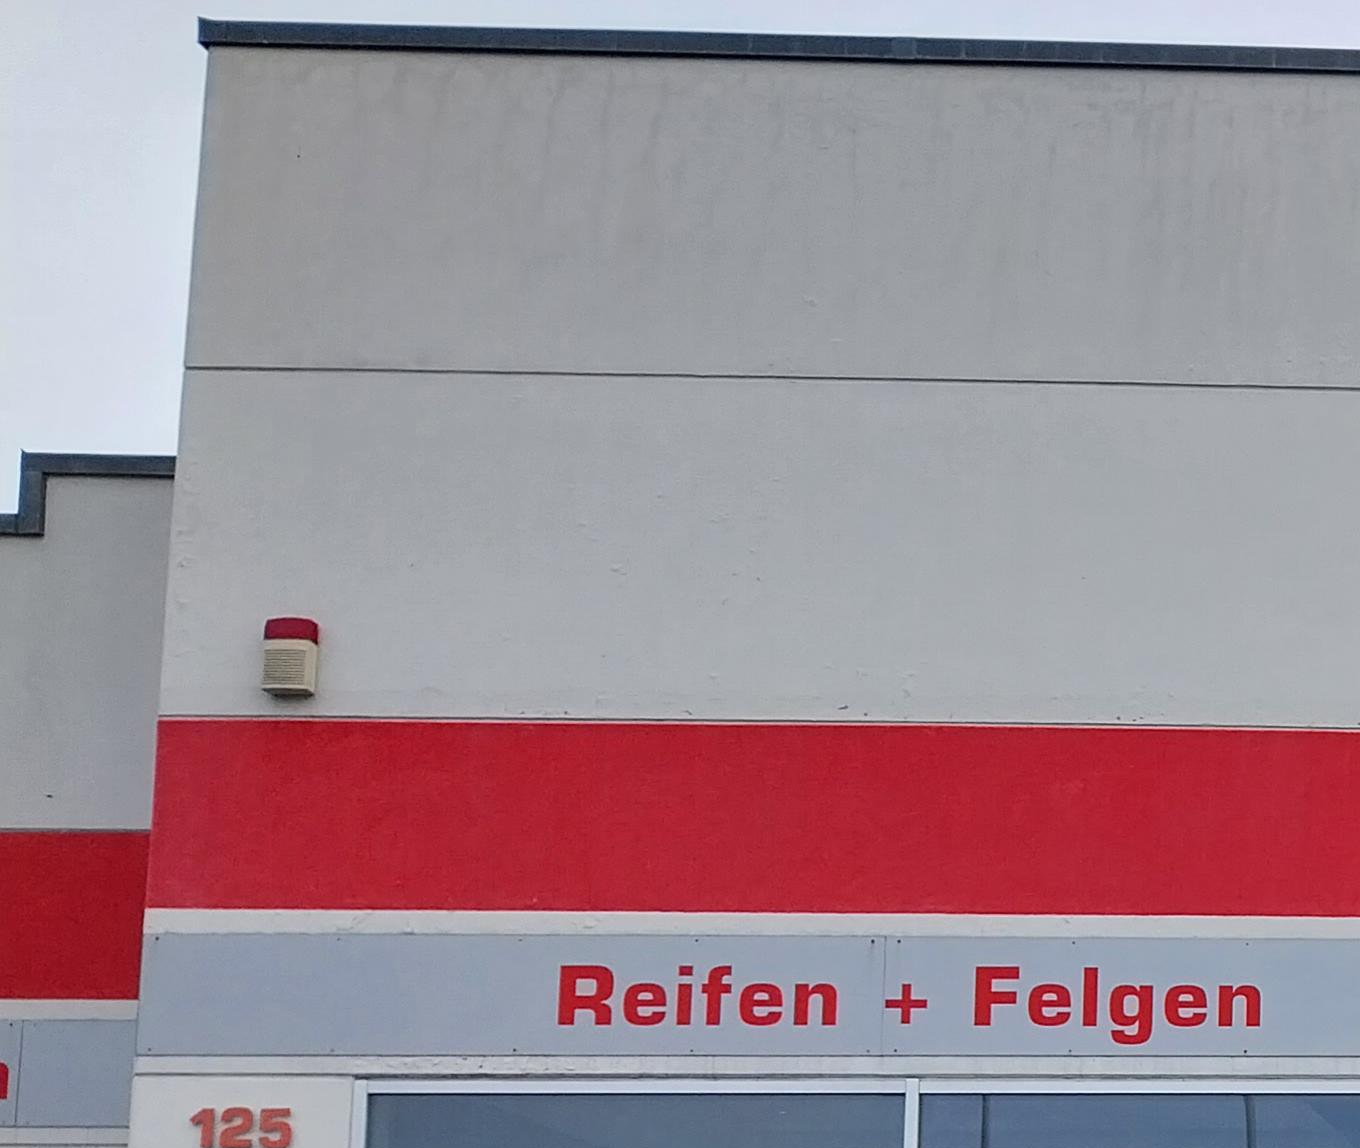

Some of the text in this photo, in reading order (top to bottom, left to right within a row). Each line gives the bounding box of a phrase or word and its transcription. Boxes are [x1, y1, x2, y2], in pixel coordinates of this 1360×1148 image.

[557, 965, 1262, 1045] Reifen + Felgen
